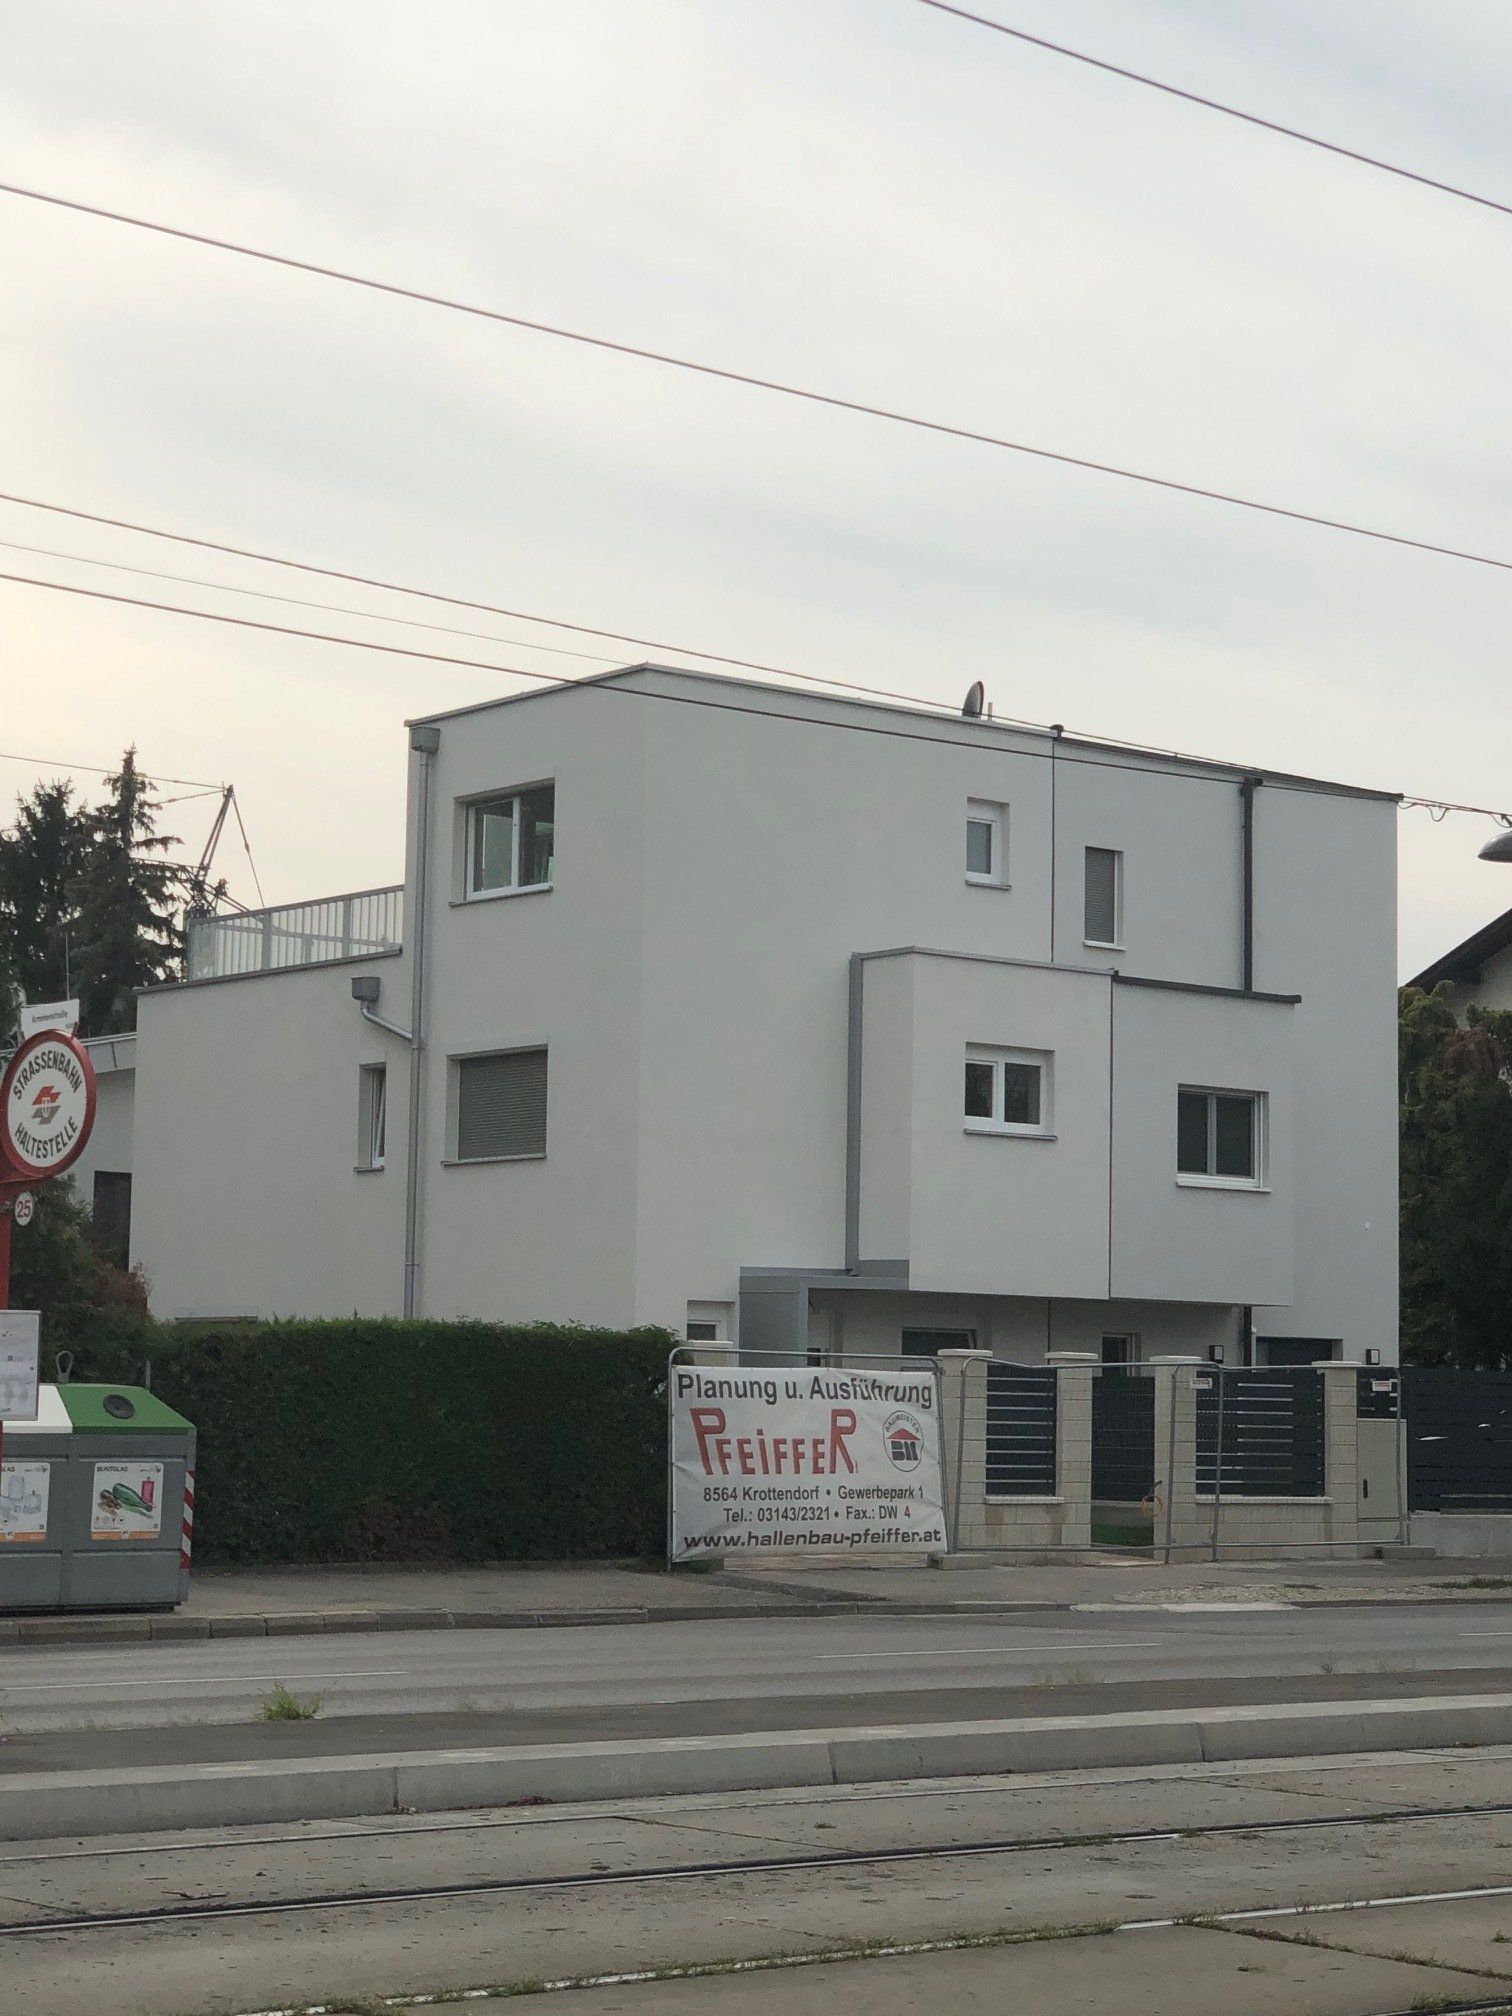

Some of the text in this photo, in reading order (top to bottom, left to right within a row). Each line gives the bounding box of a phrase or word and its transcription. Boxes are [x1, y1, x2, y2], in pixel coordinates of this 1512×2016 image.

[13, 1050, 83, 1100] STRASSENBAHN
[15, 1116, 78, 1159] HALTESTELLE
[16, 1200, 31, 1218] 25
[677, 1373, 933, 1409] Planung u. Ausführung
[703, 1485, 924, 1502] 8564 Krottendorf Gewerbepark 1
[723, 1506, 911, 1523] Tel.: 03143/2321 Fax.: DW 4
[683, 1528, 942, 1549] www.hallenbau-pfeiffer.at
